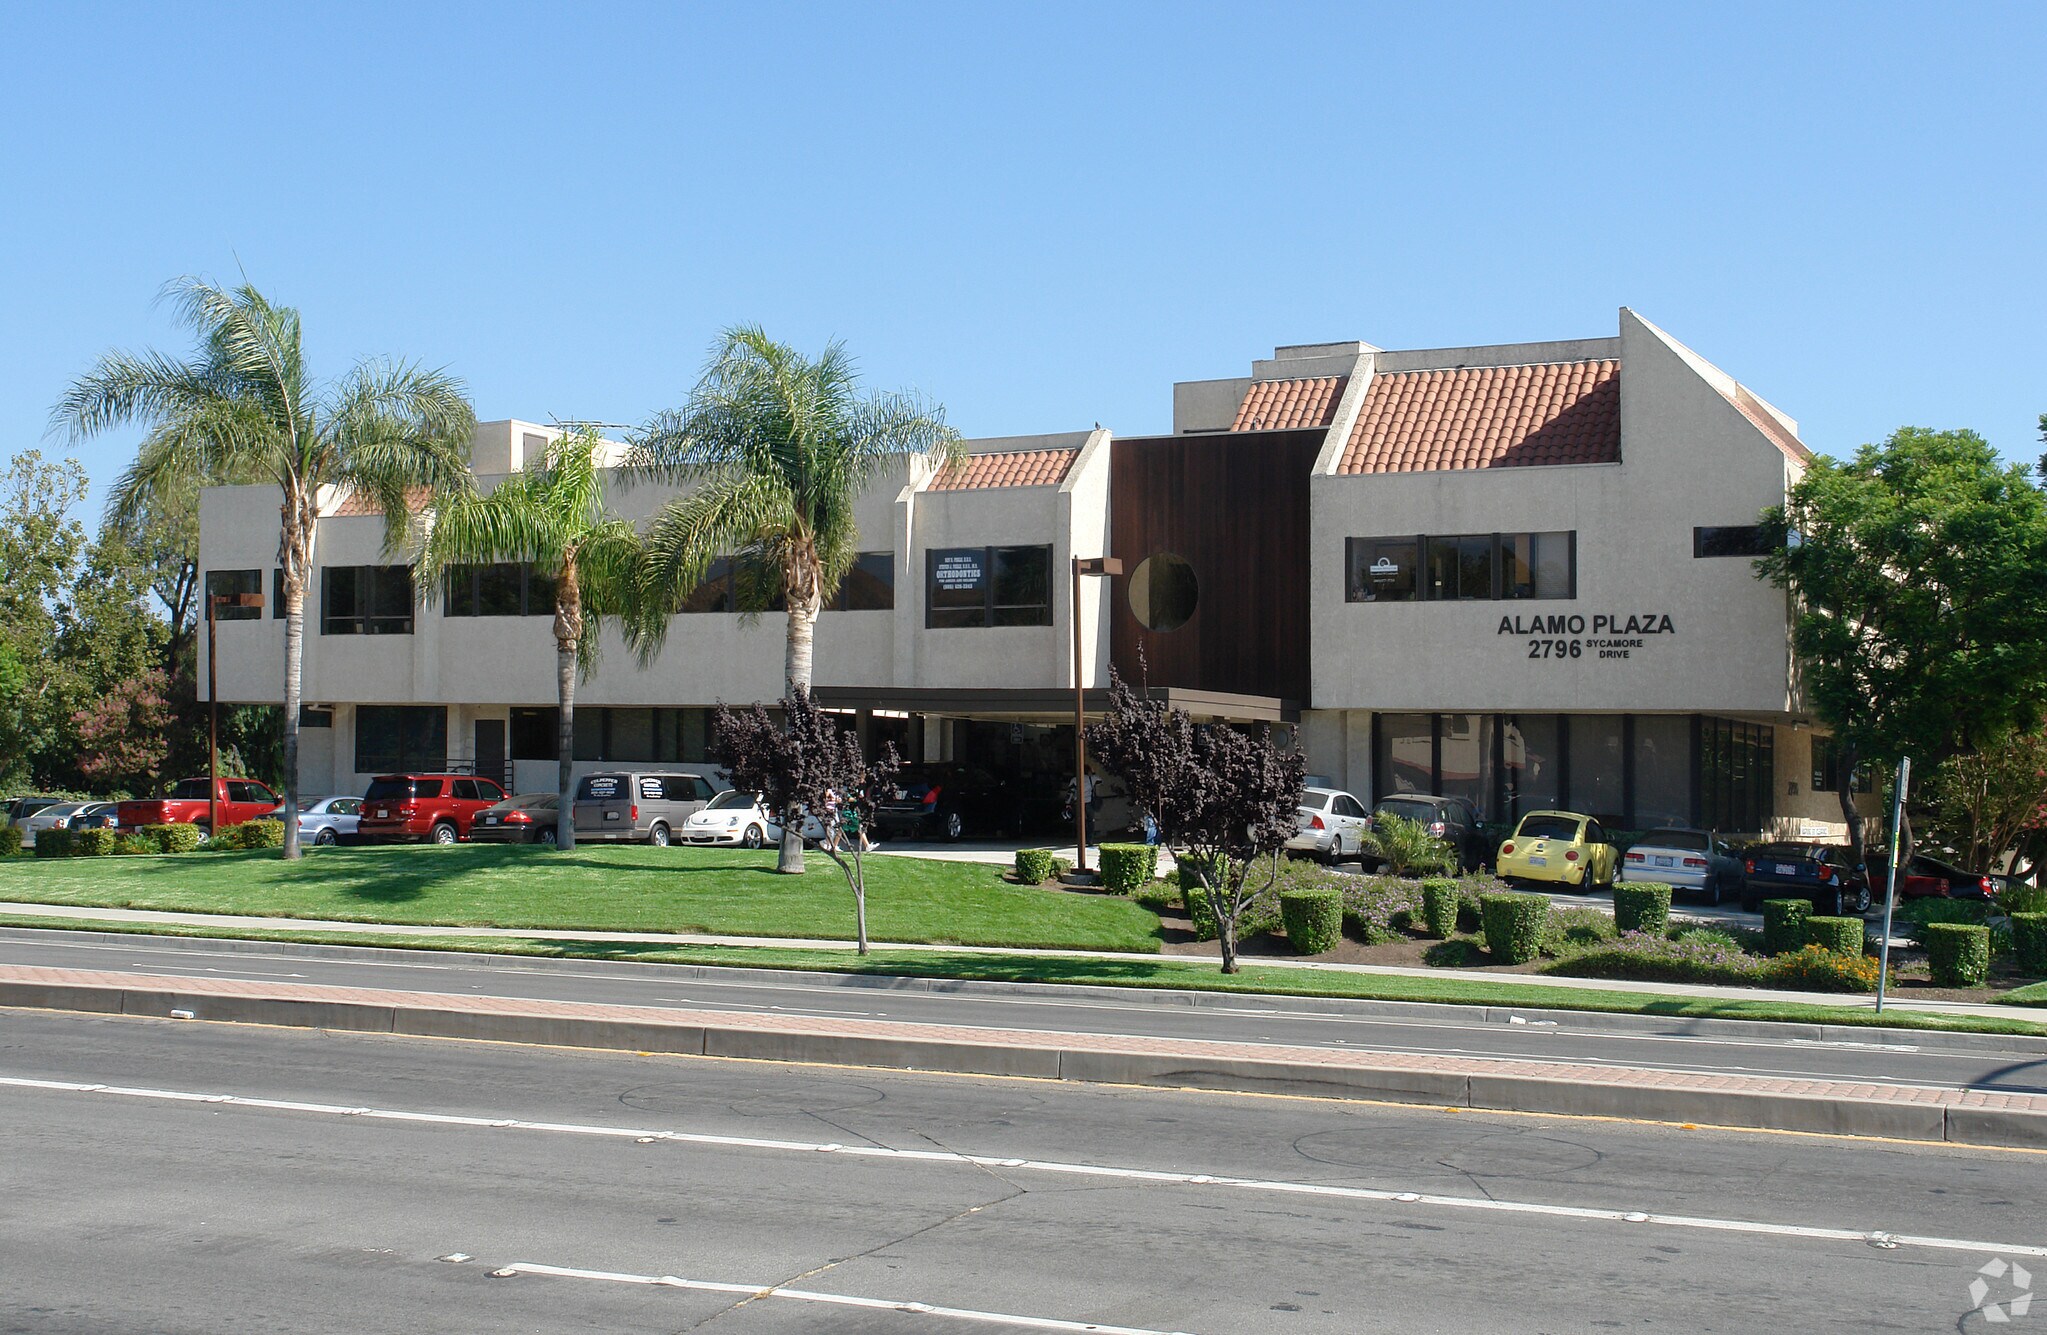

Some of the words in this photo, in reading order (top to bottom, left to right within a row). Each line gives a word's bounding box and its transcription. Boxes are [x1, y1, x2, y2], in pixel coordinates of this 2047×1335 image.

[936, 569, 981, 579] ORTHODONTICS
[1497, 614, 1585, 635] ALAMO
[1593, 614, 1675, 634] PLAZA
[1586, 639, 1643, 648] SYCAMORE
[1528, 639, 1582, 659] 2796
[1599, 650, 1630, 659] DRIVE
